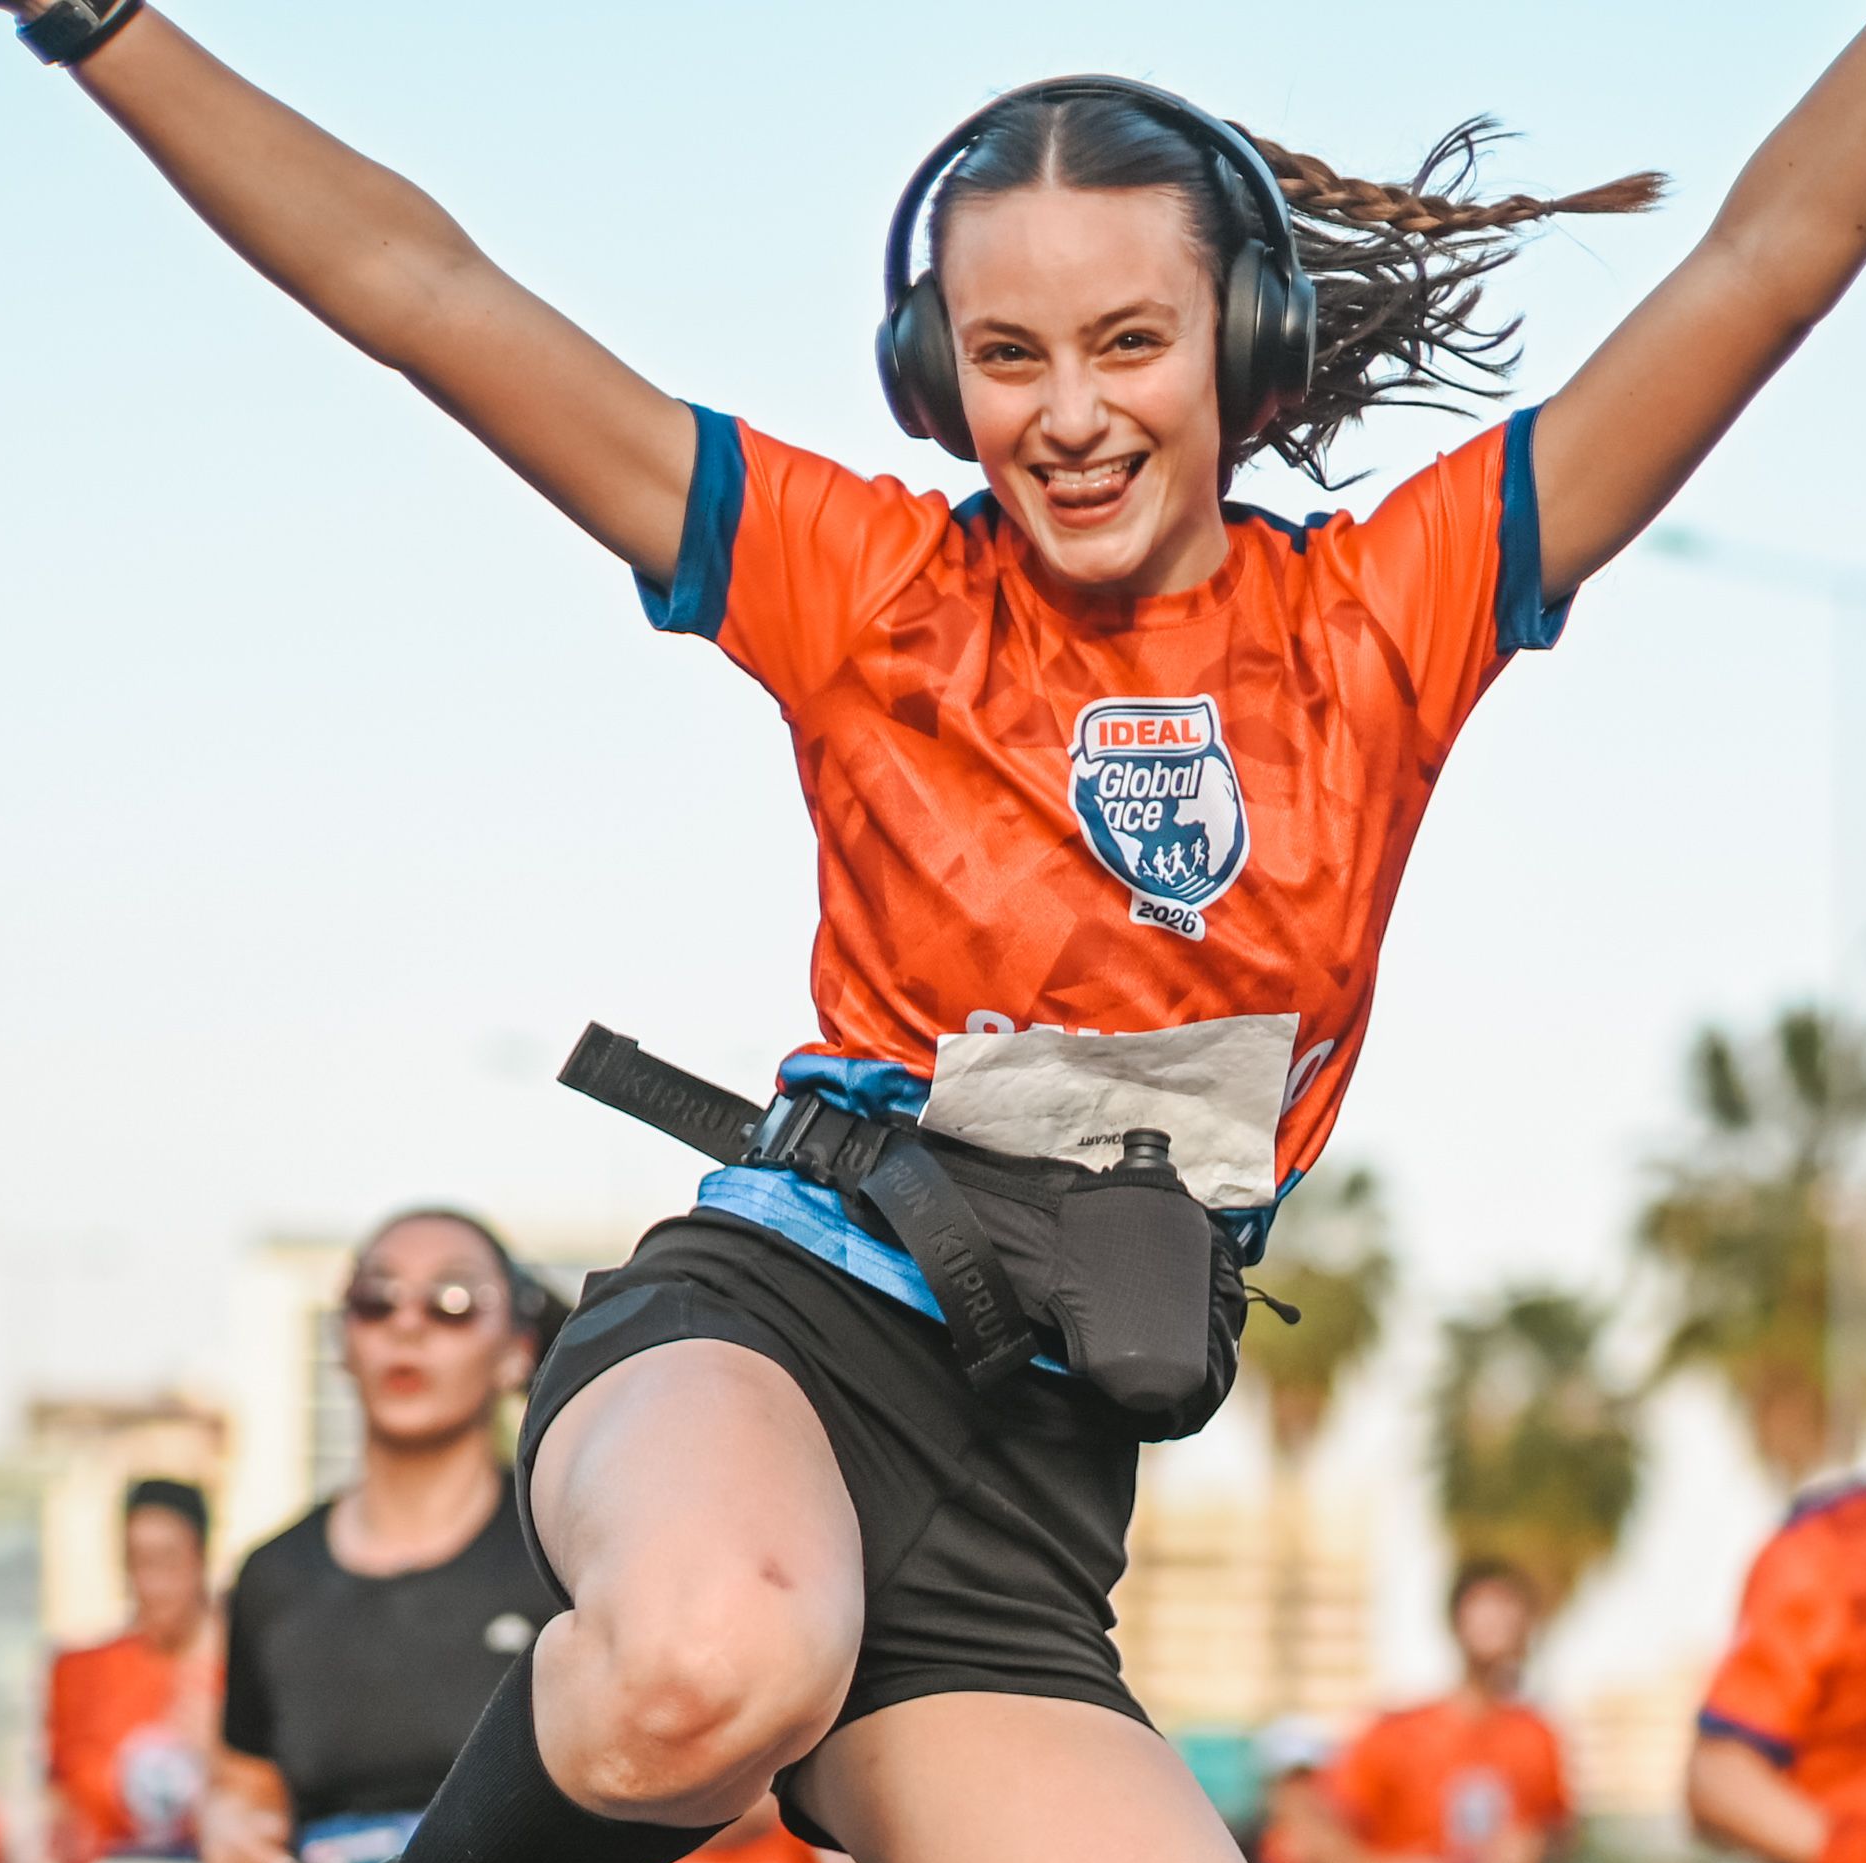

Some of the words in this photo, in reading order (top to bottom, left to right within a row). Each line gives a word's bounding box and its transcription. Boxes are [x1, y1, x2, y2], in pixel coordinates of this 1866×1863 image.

[1099, 718, 1202, 746] IDEAL
[1098, 759, 1203, 799] Global
[1096, 797, 1164, 832] ace
[1136, 901, 1198, 934] 2026
